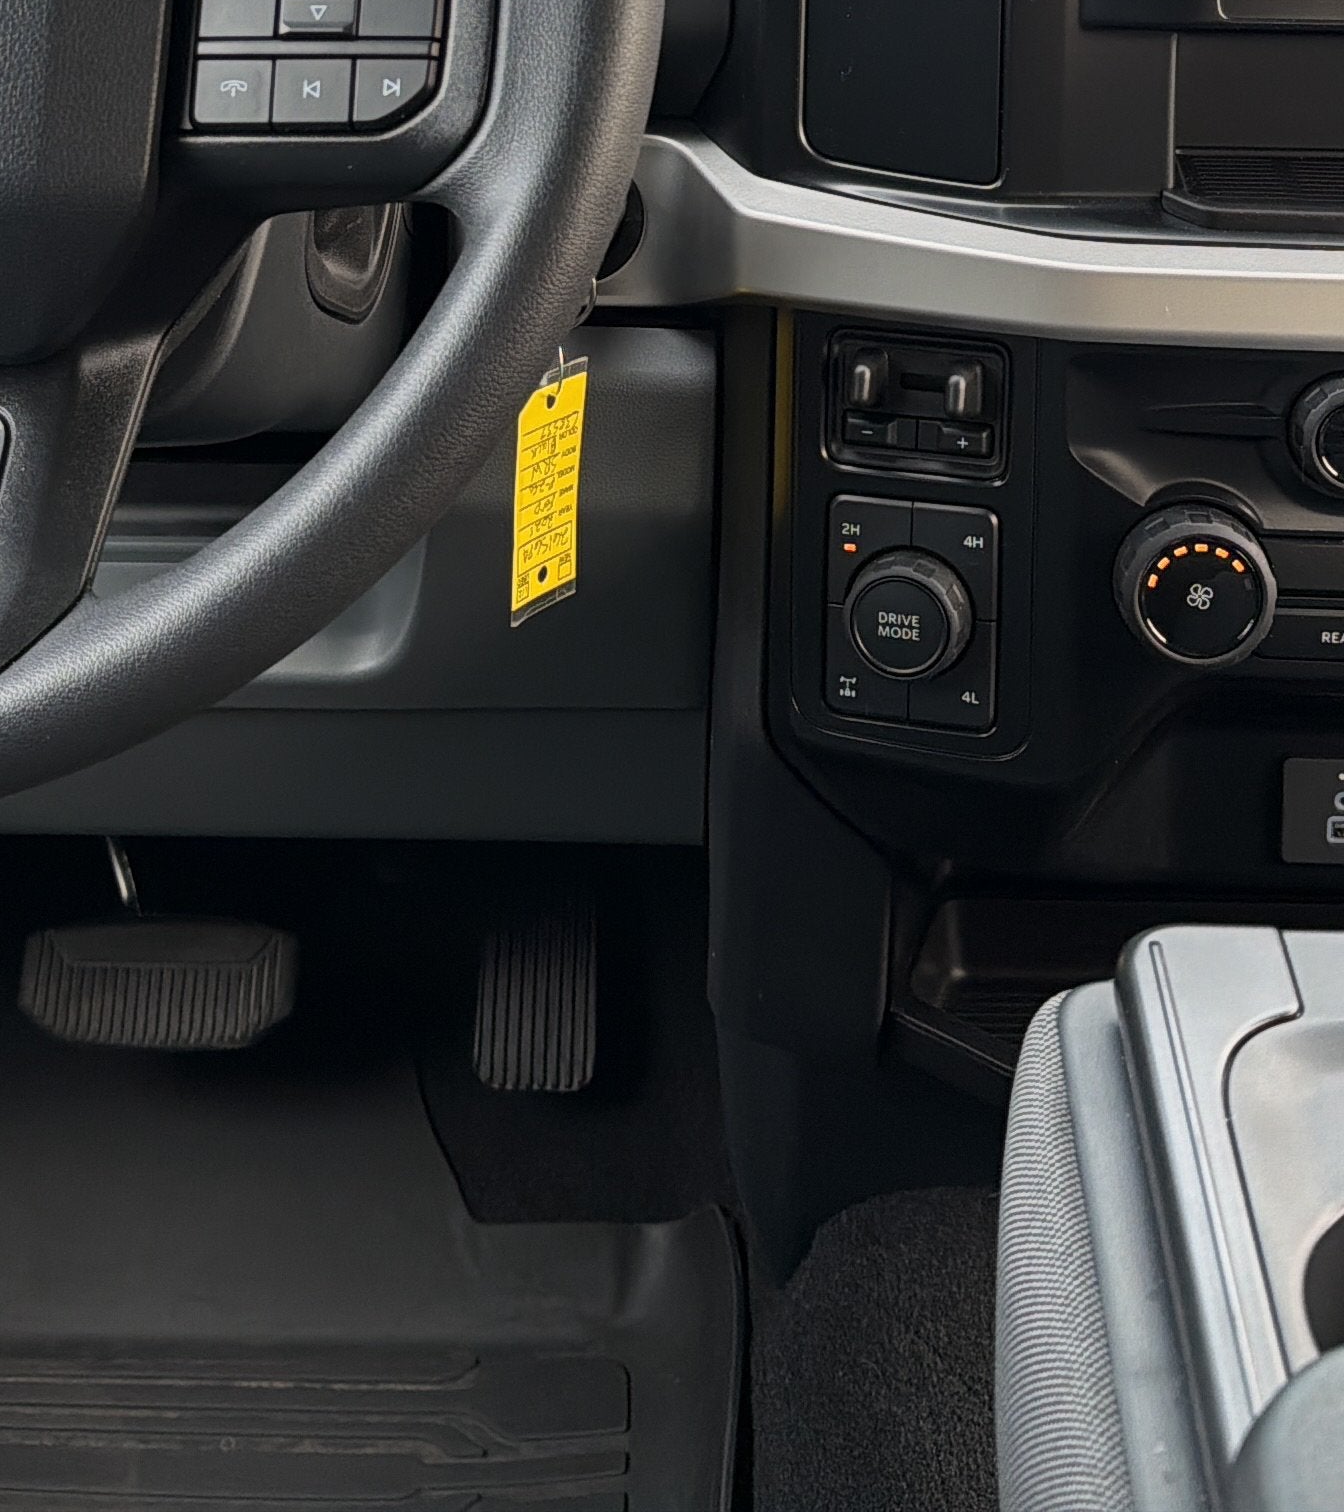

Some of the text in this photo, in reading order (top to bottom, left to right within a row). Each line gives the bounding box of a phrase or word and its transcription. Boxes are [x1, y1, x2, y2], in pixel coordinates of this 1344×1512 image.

[841, 523, 861, 536] 2H
[962, 535, 984, 549] 4H
[878, 611, 920, 627] DRIVE
[877, 625, 920, 641] MODE
[961, 691, 980, 705] 4L
